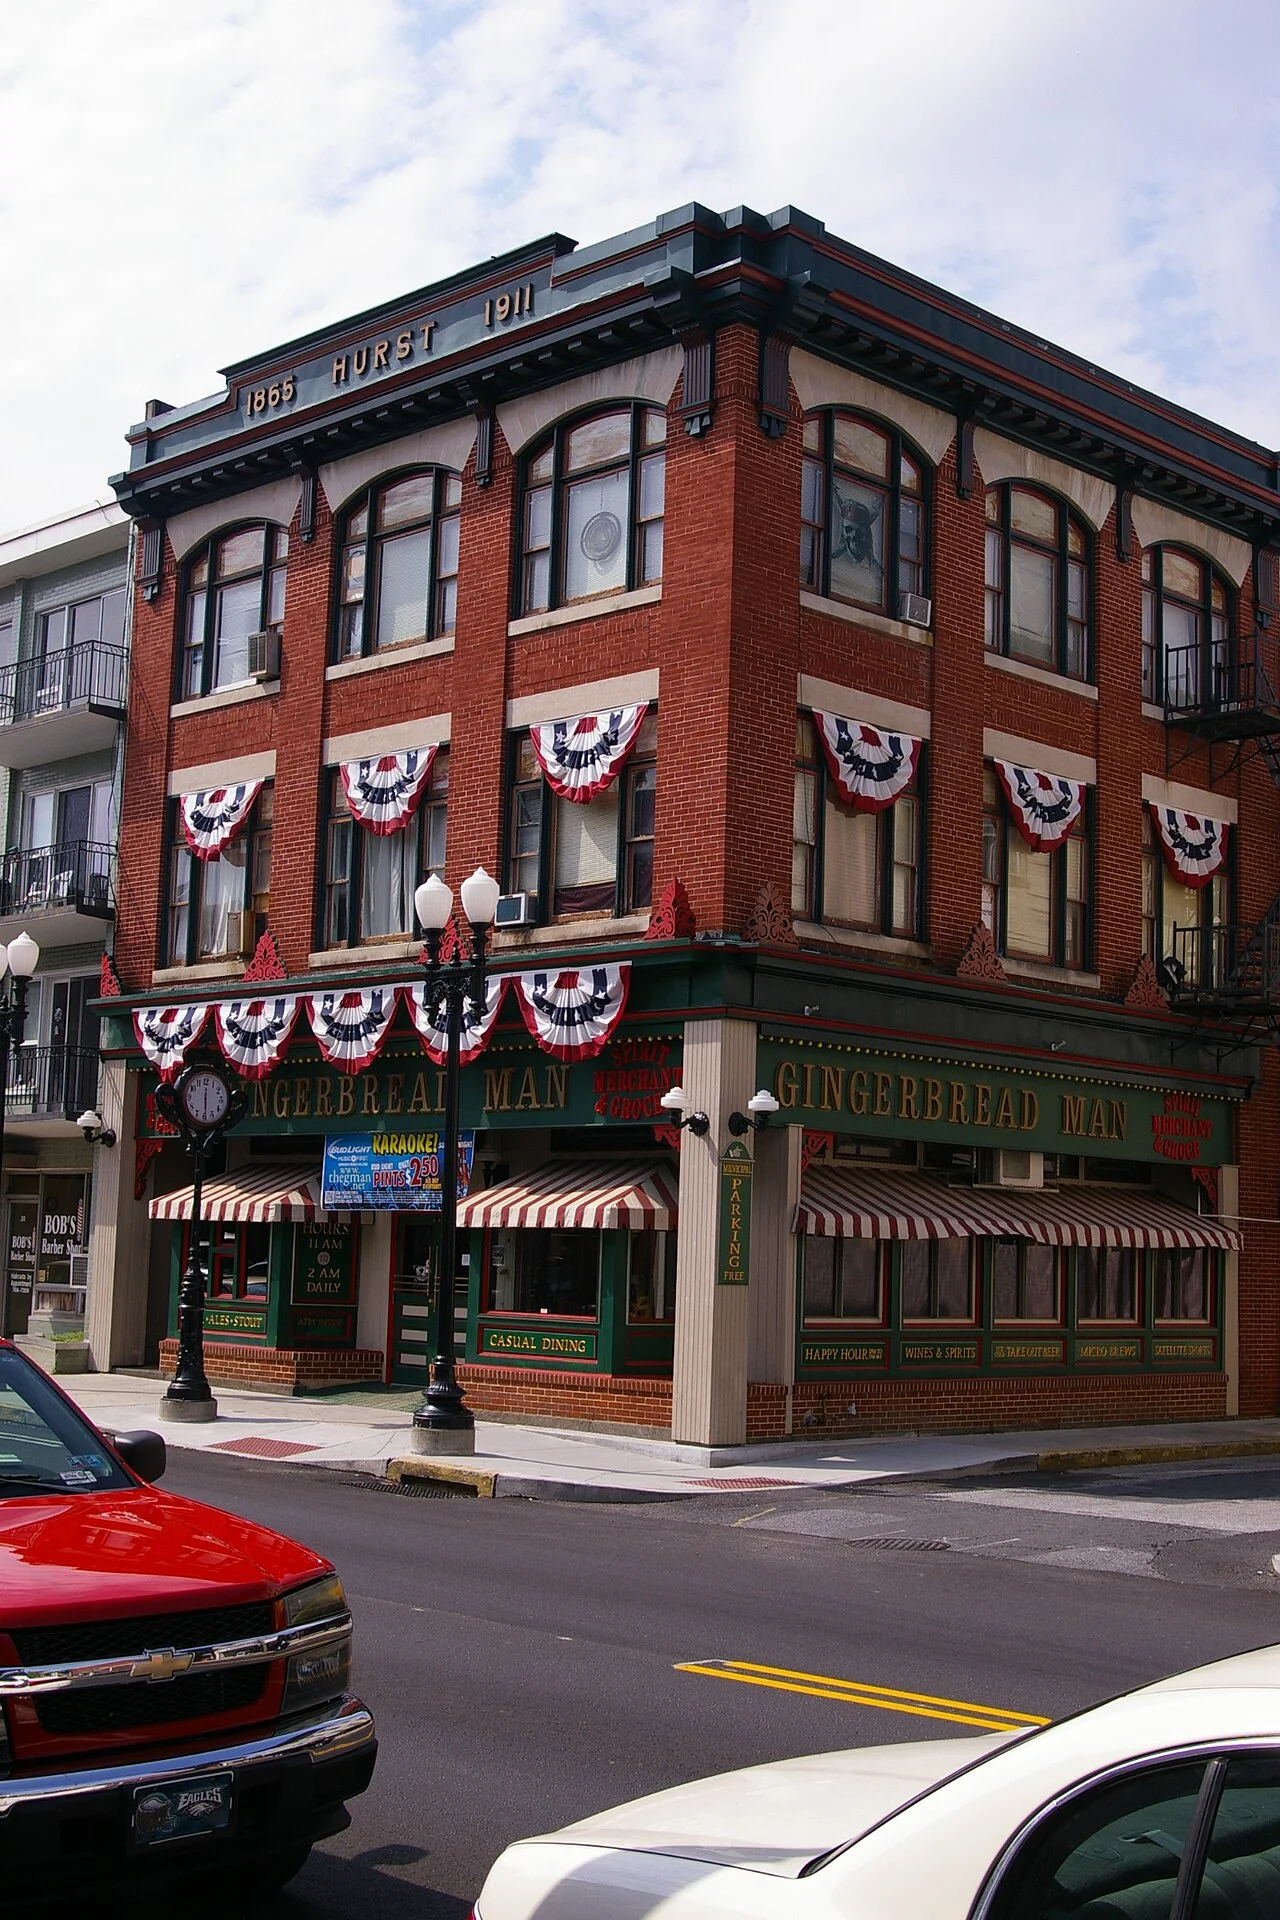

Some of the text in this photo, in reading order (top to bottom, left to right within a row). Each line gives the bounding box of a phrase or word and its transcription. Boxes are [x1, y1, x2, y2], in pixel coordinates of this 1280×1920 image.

[484, 283, 532, 326] 1911
[331, 320, 437, 384] HURST
[247, 375, 295, 416] 1865
[612, 1041, 672, 1067] SPIRIT
[483, 1064, 571, 1112] MAN
[593, 1067, 682, 1093] MERCHANT
[594, 1093, 607, 1115] &
[775, 1060, 1128, 1140] GINGERBREAD MAN
[1164, 1091, 1203, 1117] SPIRIT
[1152, 1114, 1212, 1138] MERCHANT
[330, 1146, 347, 1154] BUD
[372, 1133, 439, 1154] KARAOKE!
[1153, 1135, 1162, 1152] &
[328, 1170, 371, 1186] thegman
[372, 1170, 405, 1187] PINTS
[44, 1214, 77, 1235] BOB'S
[303, 1222, 350, 1236] HOURS
[728, 1178, 742, 1268] PARKING
[12, 1236, 31, 1249] BOB'S
[41, 1238, 64, 1254] Barber
[308, 1239, 343, 1249] 11 AM
[10, 1250, 24, 1260] Barber
[308, 1268, 340, 1279] 2 AM
[724, 1271, 744, 1281] FREE
[307, 1282, 341, 1293] DAILY
[489, 1334, 586, 1353] CASUAL DINING
[1006, 1346, 1026, 1358] TAKE
[1027, 1346, 1041, 1358] OUT
[1043, 1346, 1060, 1358] BEER
[1080, 1345, 1136, 1357] MICRO BREWS
[1154, 1345, 1187, 1356] SATELLITE
[805, 1348, 838, 1361] HAPPY
[840, 1348, 869, 1360] HOUR
[905, 1347, 976, 1359] WINES & SPIRITS
[177, 1787, 222, 1811] EAGLES
